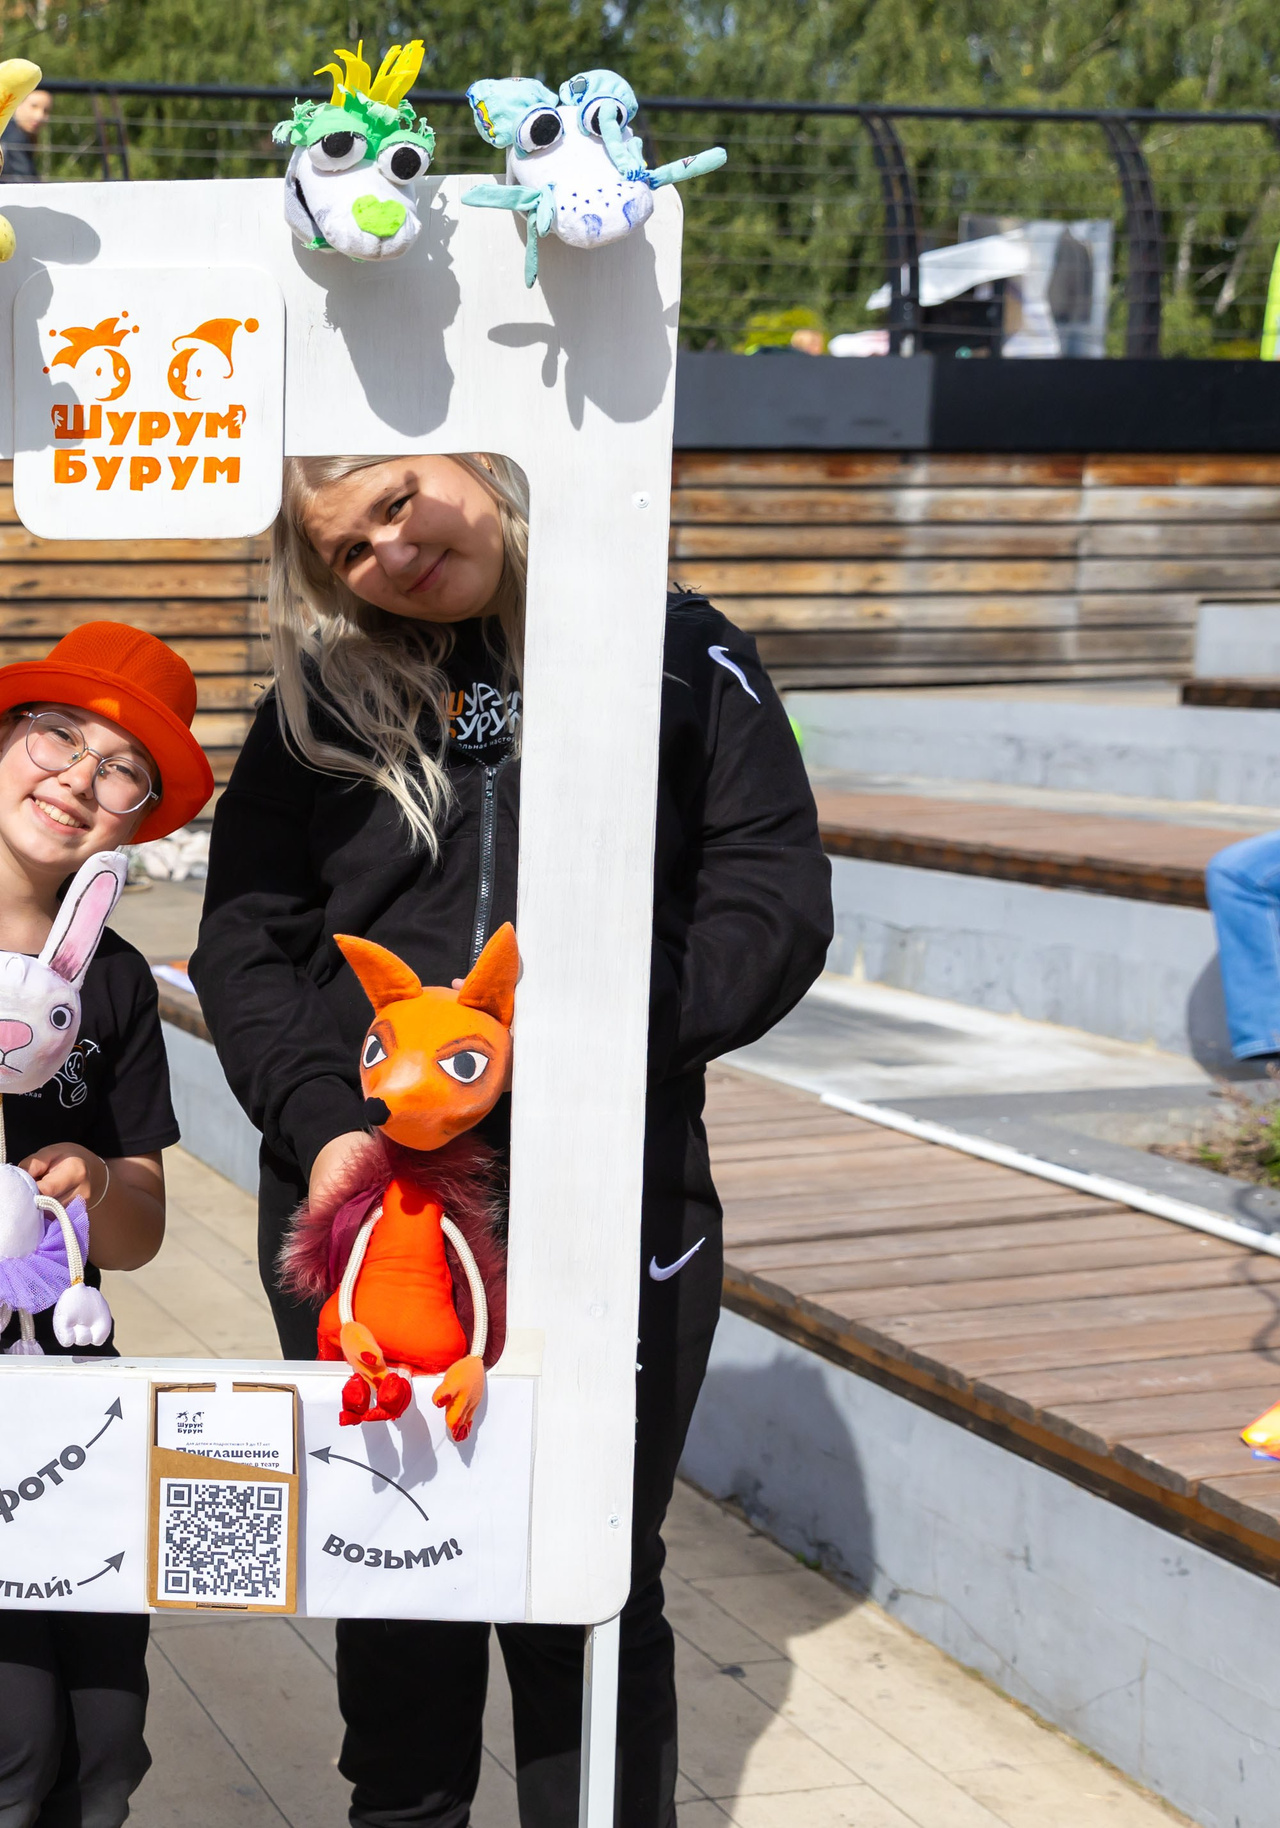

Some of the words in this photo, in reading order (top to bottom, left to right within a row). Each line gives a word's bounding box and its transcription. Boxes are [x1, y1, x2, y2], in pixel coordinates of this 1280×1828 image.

[51, 404, 246, 446] Шурум
[54, 449, 241, 491] Бурум
[321, 1533, 463, 1569] ВОЗЬМИ!
